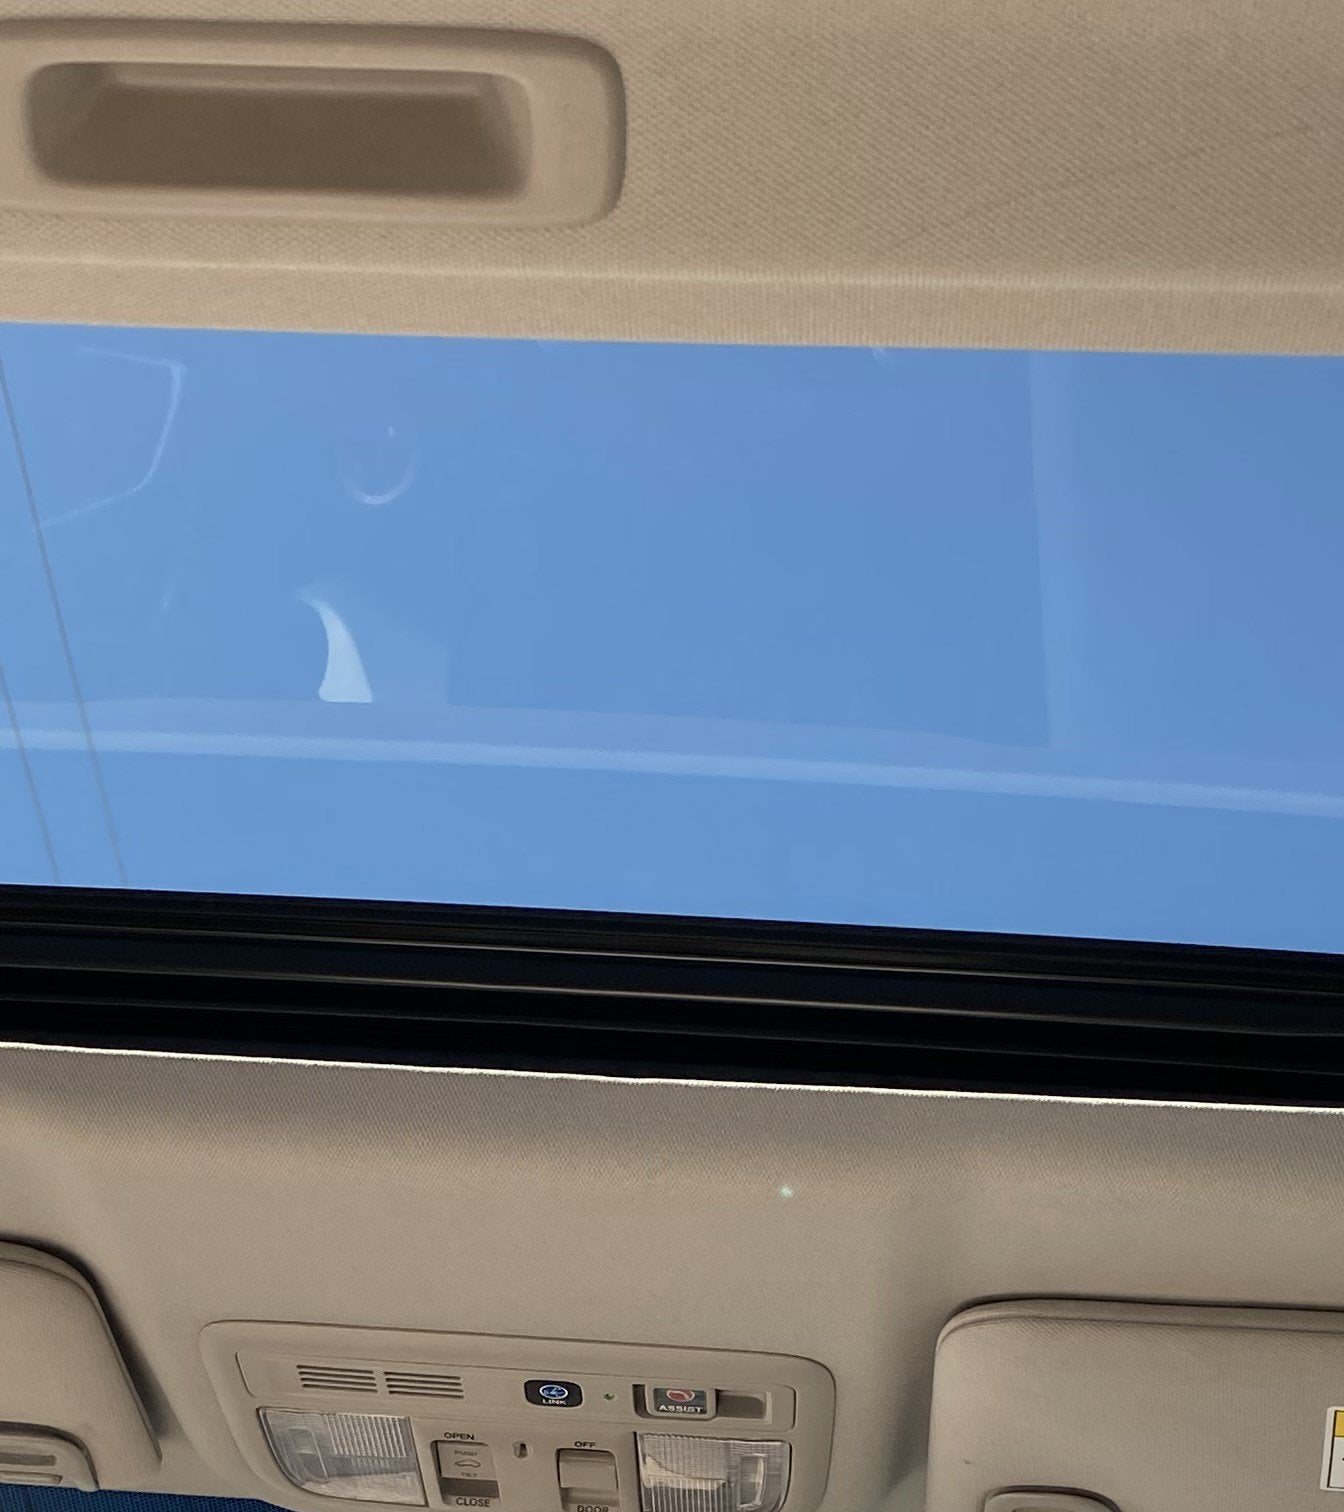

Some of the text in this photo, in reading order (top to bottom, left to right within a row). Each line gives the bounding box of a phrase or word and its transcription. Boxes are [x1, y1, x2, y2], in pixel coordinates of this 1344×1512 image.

[659, 1404, 703, 1413] ASSIST
[443, 1432, 475, 1441] OPEN
[574, 1440, 596, 1448] OFF
[456, 1497, 490, 1508] CLOSE
